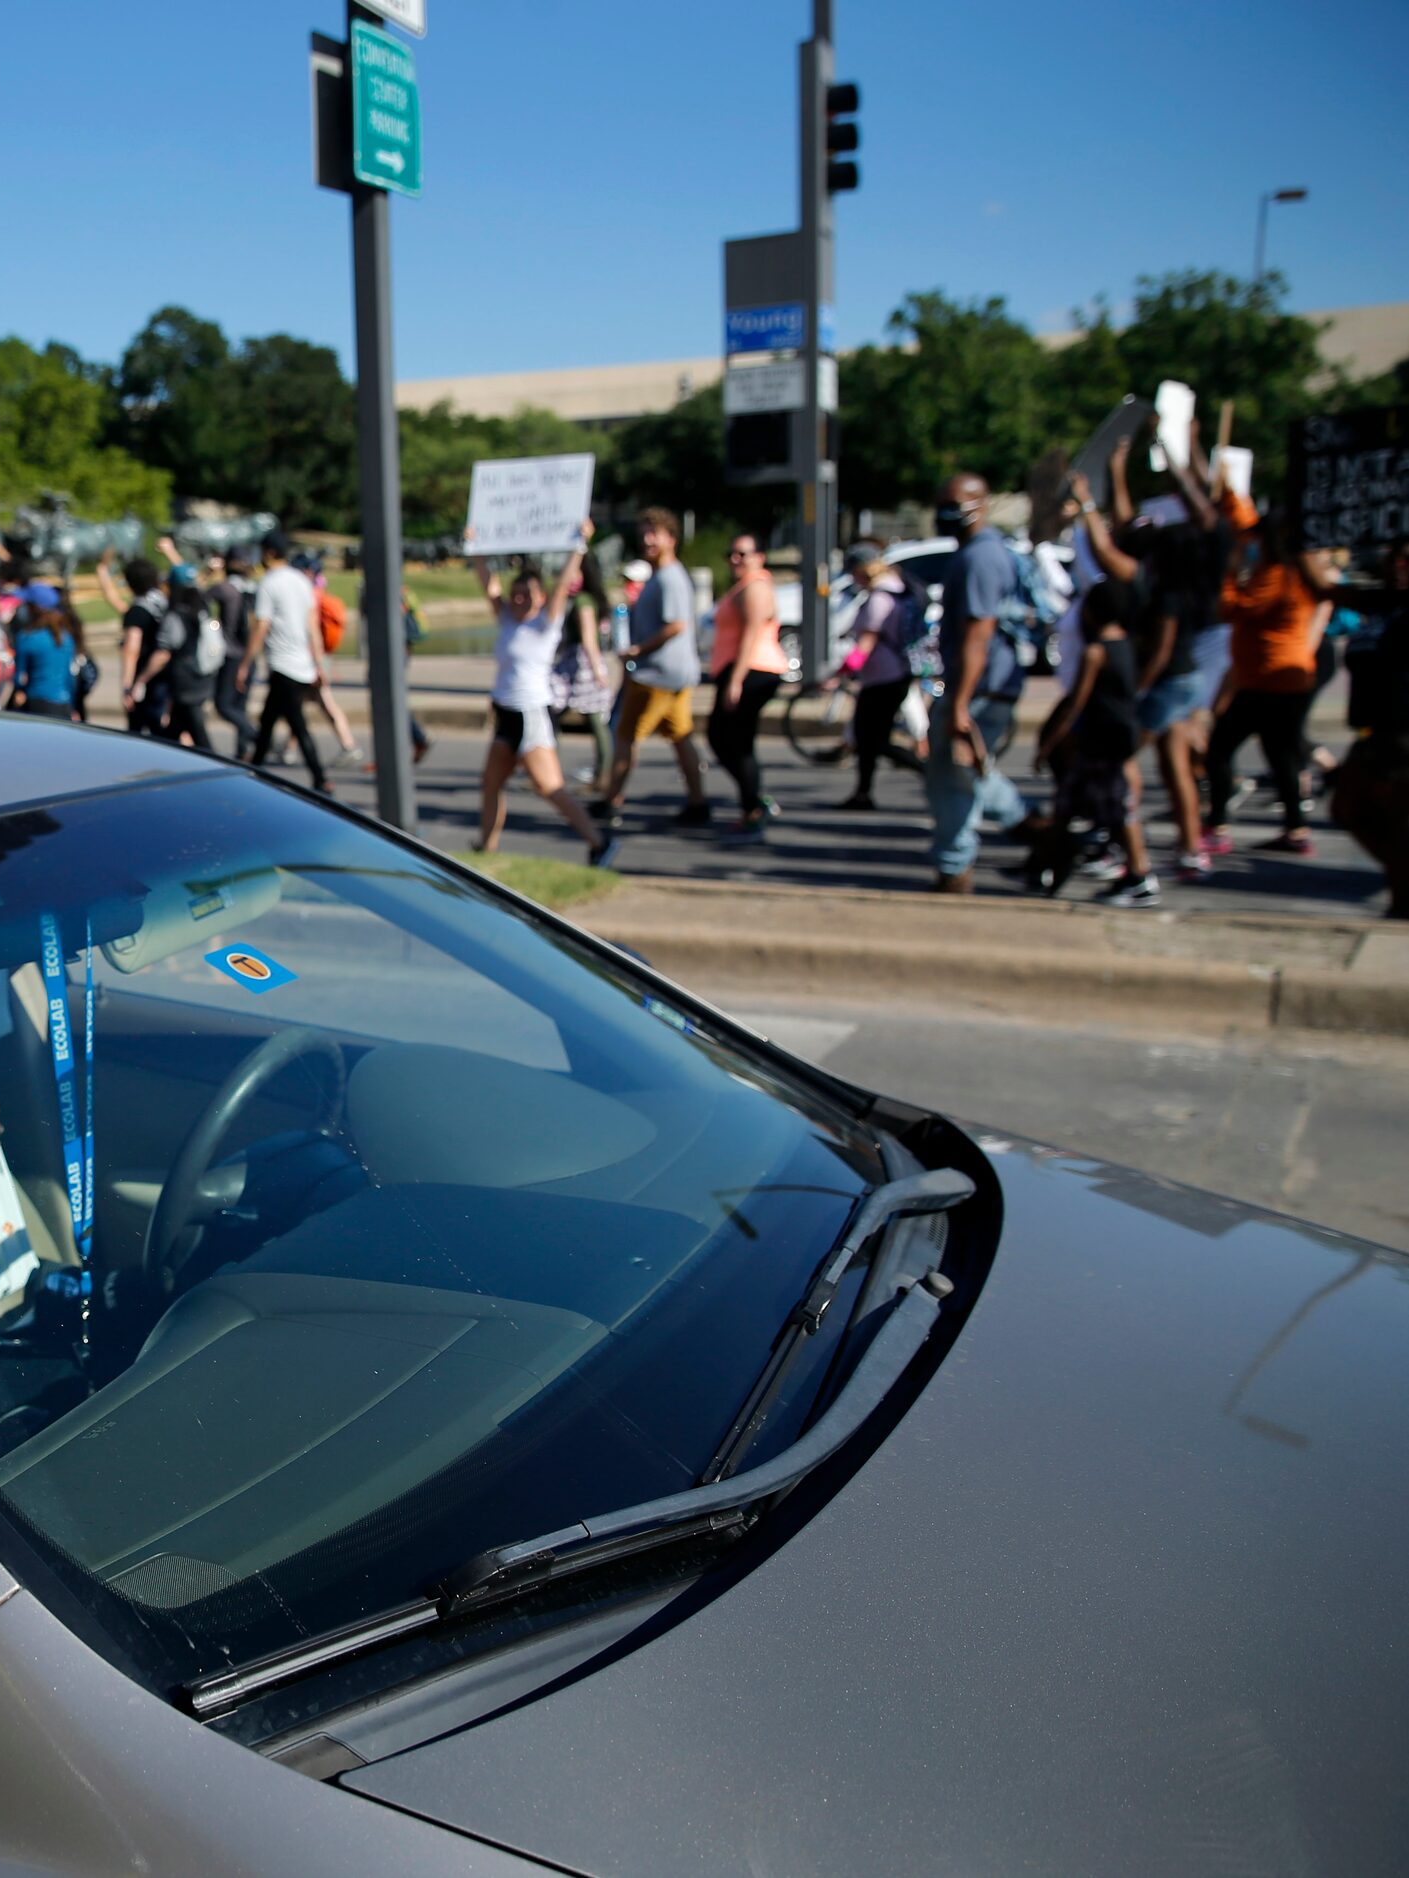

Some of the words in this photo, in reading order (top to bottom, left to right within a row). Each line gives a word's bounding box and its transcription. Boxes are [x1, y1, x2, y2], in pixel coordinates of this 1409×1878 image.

[42, 914, 60, 977] ECOLAB
[50, 998, 69, 1061] ECOLAB
[59, 1081, 76, 1142] ECOLAB
[68, 1161, 83, 1223] ECOLAB
